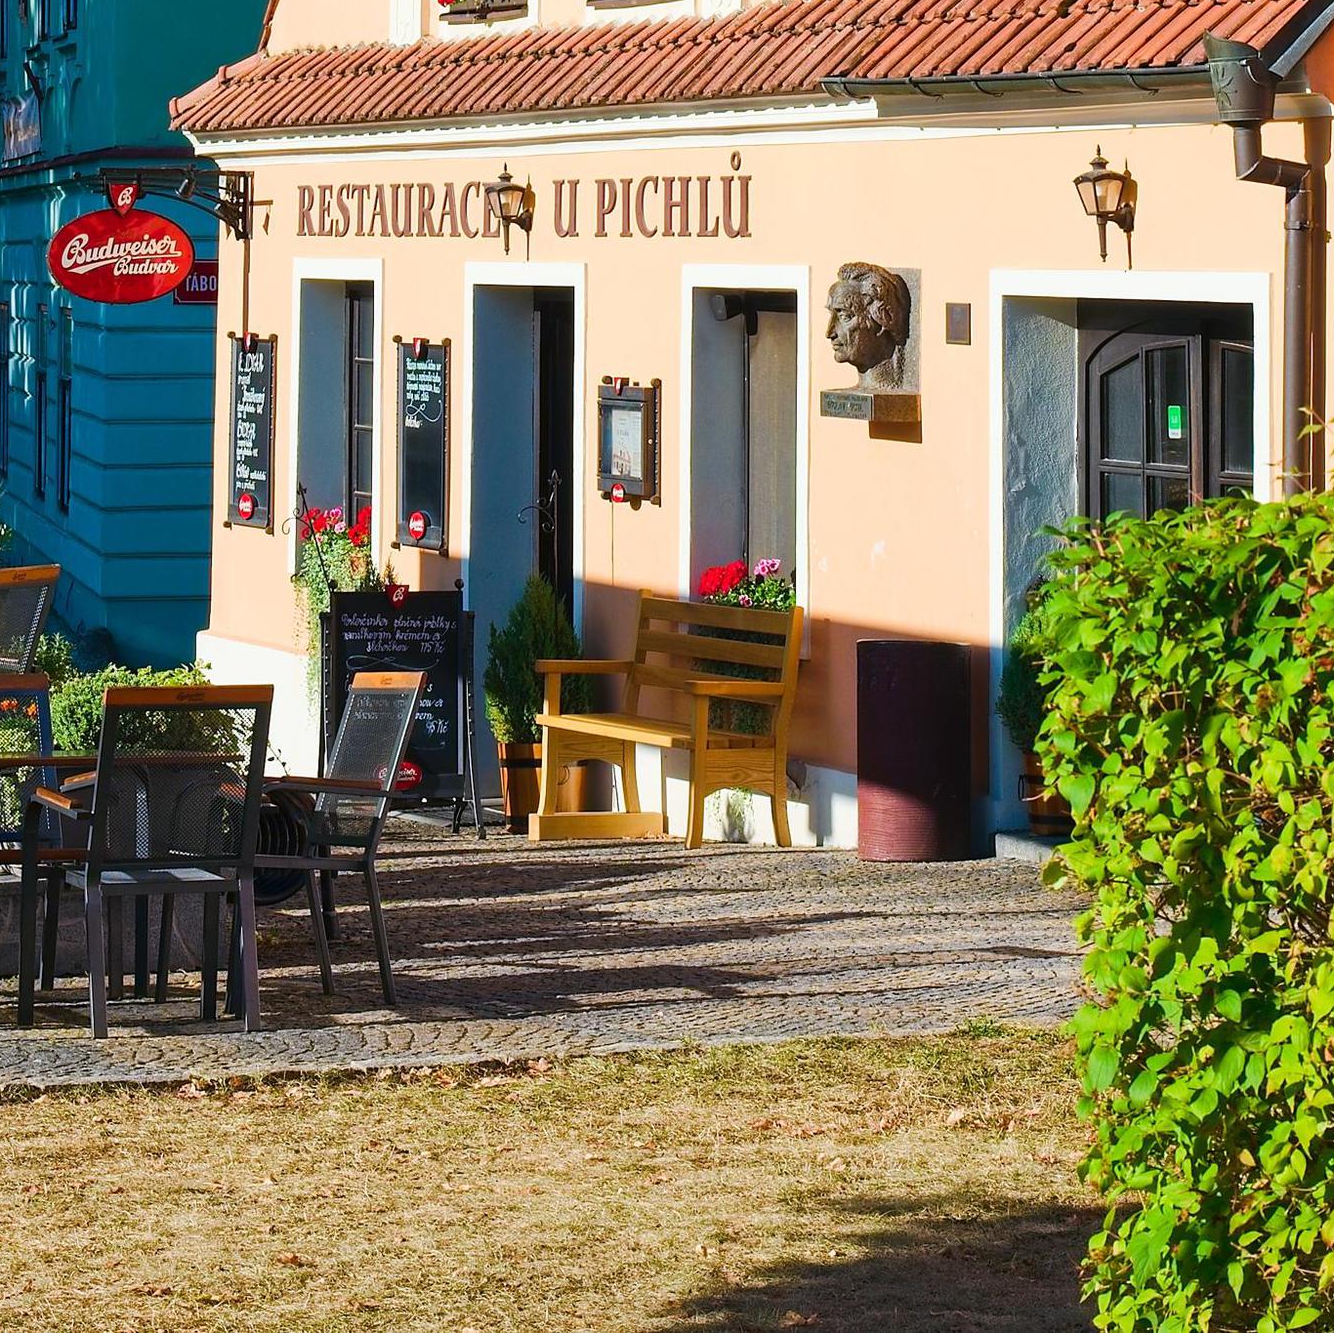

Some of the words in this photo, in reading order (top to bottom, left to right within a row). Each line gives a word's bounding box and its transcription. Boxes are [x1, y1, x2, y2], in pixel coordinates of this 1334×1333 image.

[117, 186, 134, 207] B
[296, 180, 501, 238] RESTAURACE
[552, 179, 580, 238] U
[595, 150, 753, 238] PICHLŮ
[61, 233, 182, 273] Budweiser
[113, 255, 179, 277] Budvar
[185, 271, 217, 292] TÁBO
